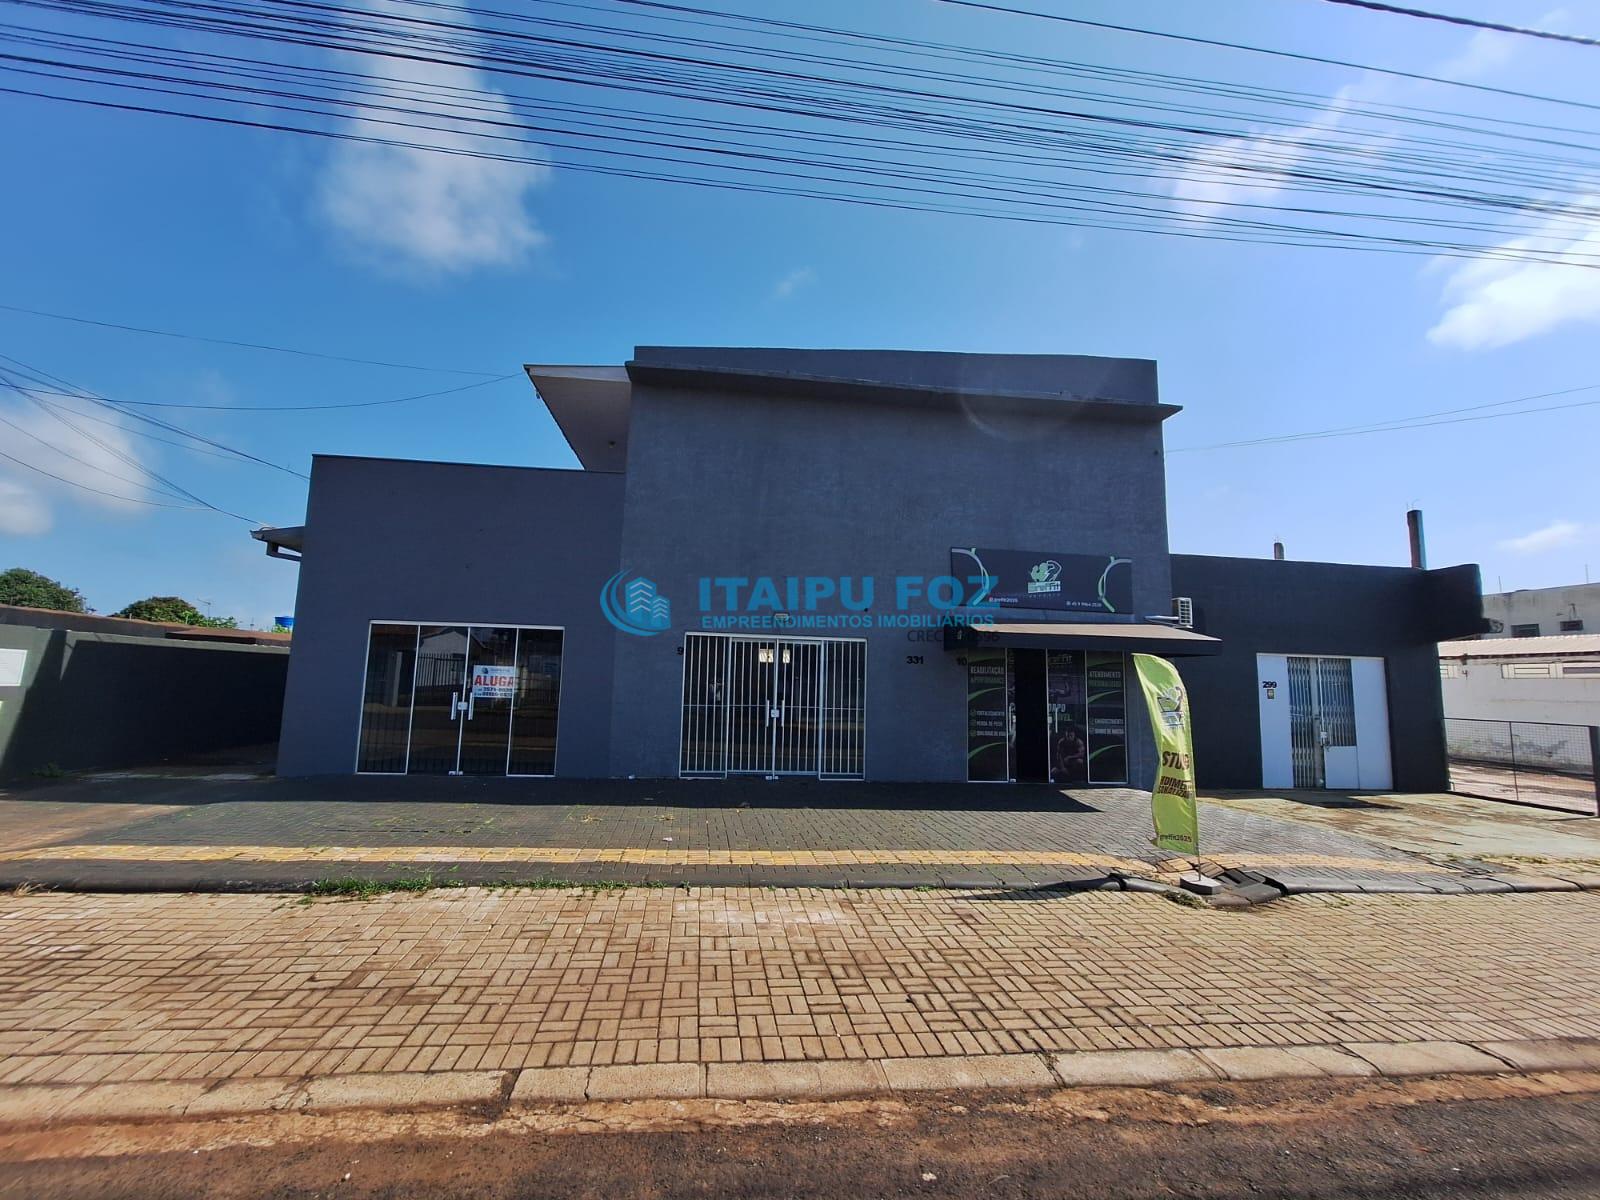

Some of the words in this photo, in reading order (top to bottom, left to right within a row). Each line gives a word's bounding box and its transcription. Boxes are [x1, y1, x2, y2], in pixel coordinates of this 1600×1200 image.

[906, 655, 924, 665] 331
[957, 656, 967, 666] 10
[475, 675, 513, 687] ALUGA
